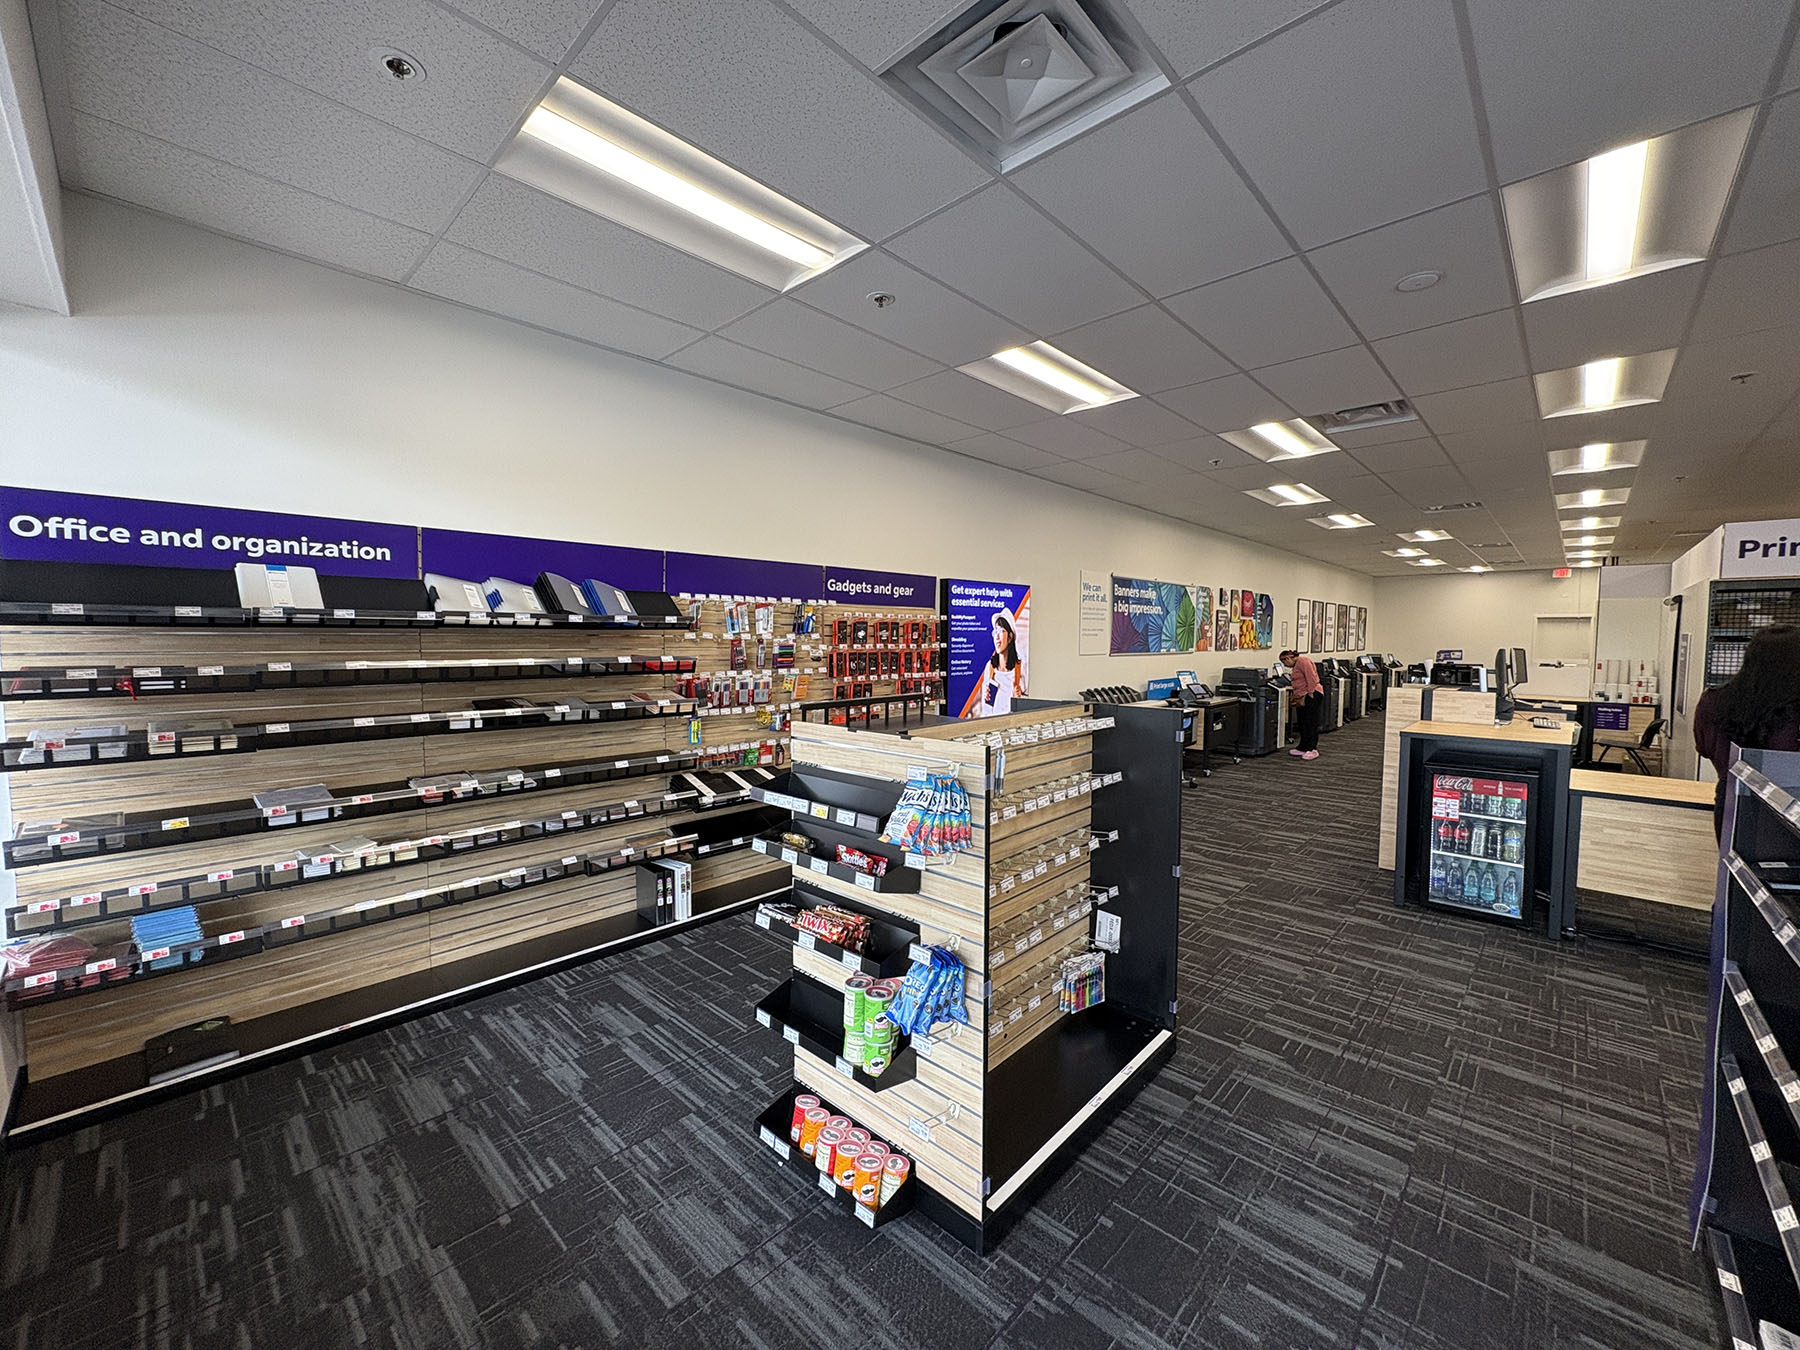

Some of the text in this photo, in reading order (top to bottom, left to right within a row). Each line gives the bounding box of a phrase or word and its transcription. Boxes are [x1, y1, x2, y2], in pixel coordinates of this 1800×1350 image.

[9, 514, 392, 561] Office and organization
[827, 578, 914, 599] Gadgets and gear
[951, 584, 1013, 598] Get expert help with
[1083, 582, 1101, 592] We can
[1114, 584, 1156, 599] Banners make
[951, 598, 1005, 608] essential services
[1082, 592, 1095, 603] print
[1095, 593, 1100, 602] it
[1114, 602, 1118, 612] a
[1118, 600, 1129, 616] big
[1129, 601, 1163, 616] impression.
[841, 852, 868, 868] Skittles
[802, 912, 831, 932] TWIX
[904, 976, 926, 993] OREO
